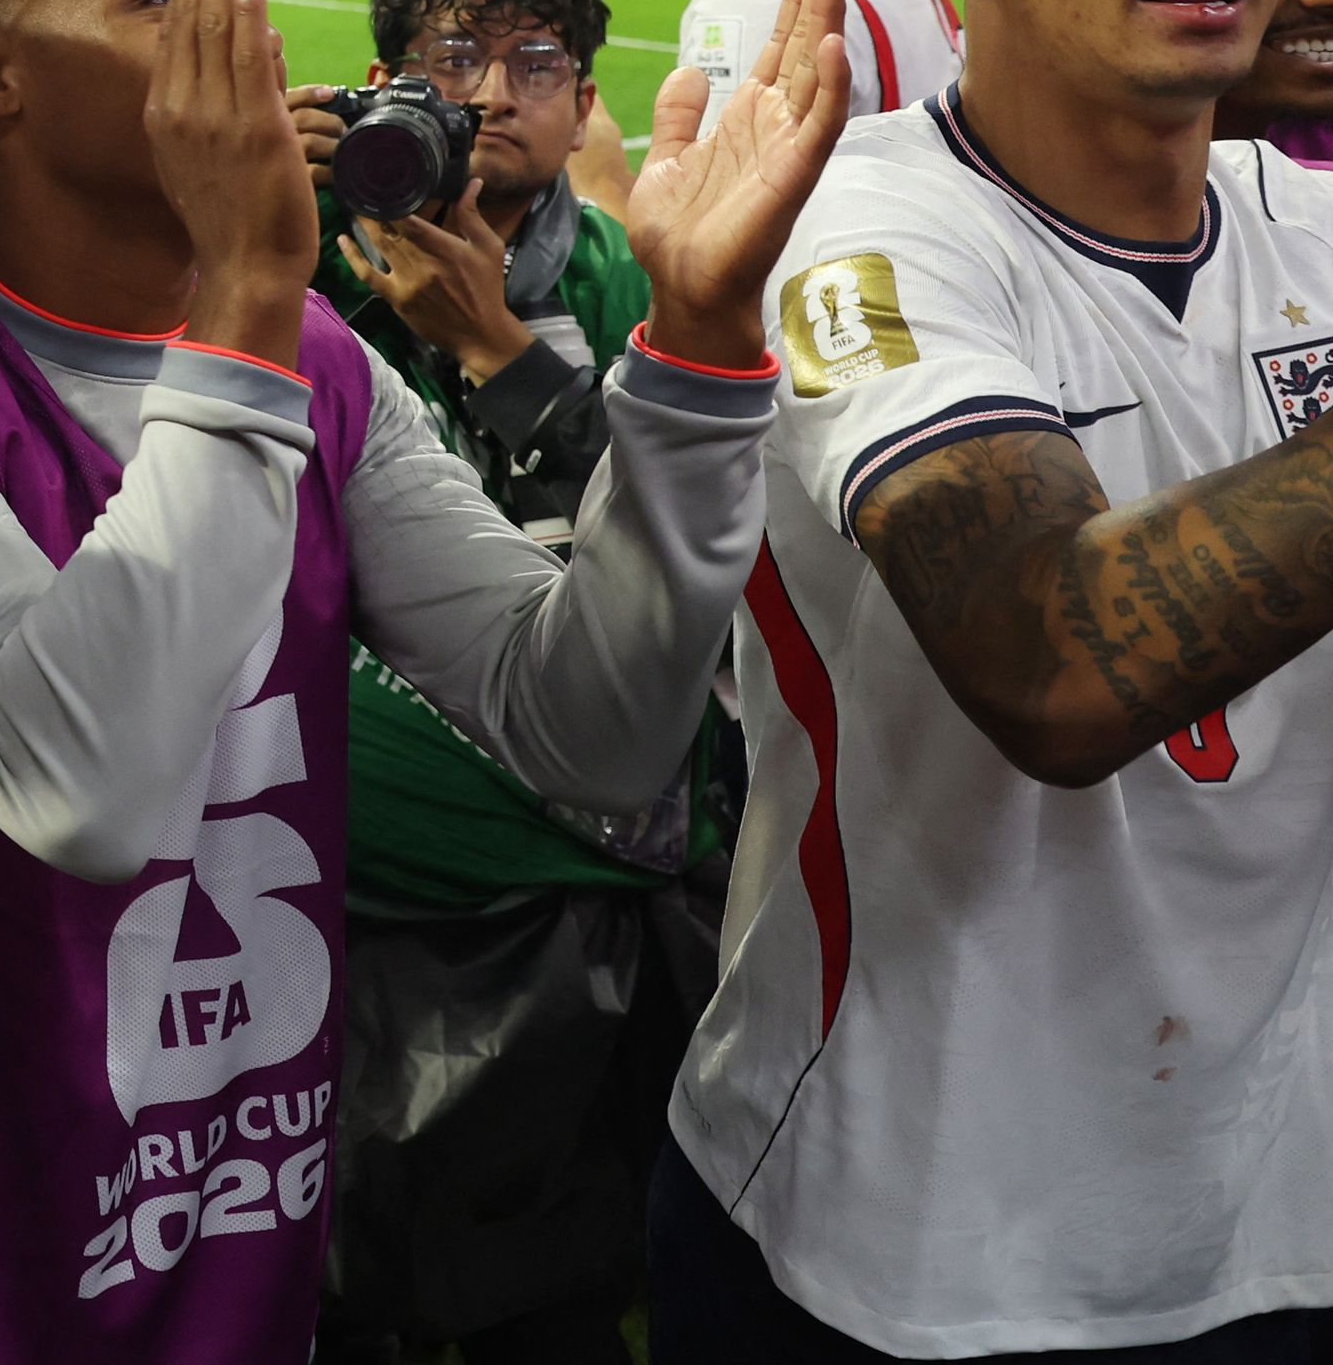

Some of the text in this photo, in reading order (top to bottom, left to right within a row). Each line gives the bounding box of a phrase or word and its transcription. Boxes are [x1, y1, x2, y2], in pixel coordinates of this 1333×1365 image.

[393, 89, 426, 100] Canon
[831, 335, 856, 351] FIFA
[824, 349, 879, 377] WORLD CUP
[95, 1080, 332, 1217] WORLD CUP
[77, 1137, 327, 1299] 2026
